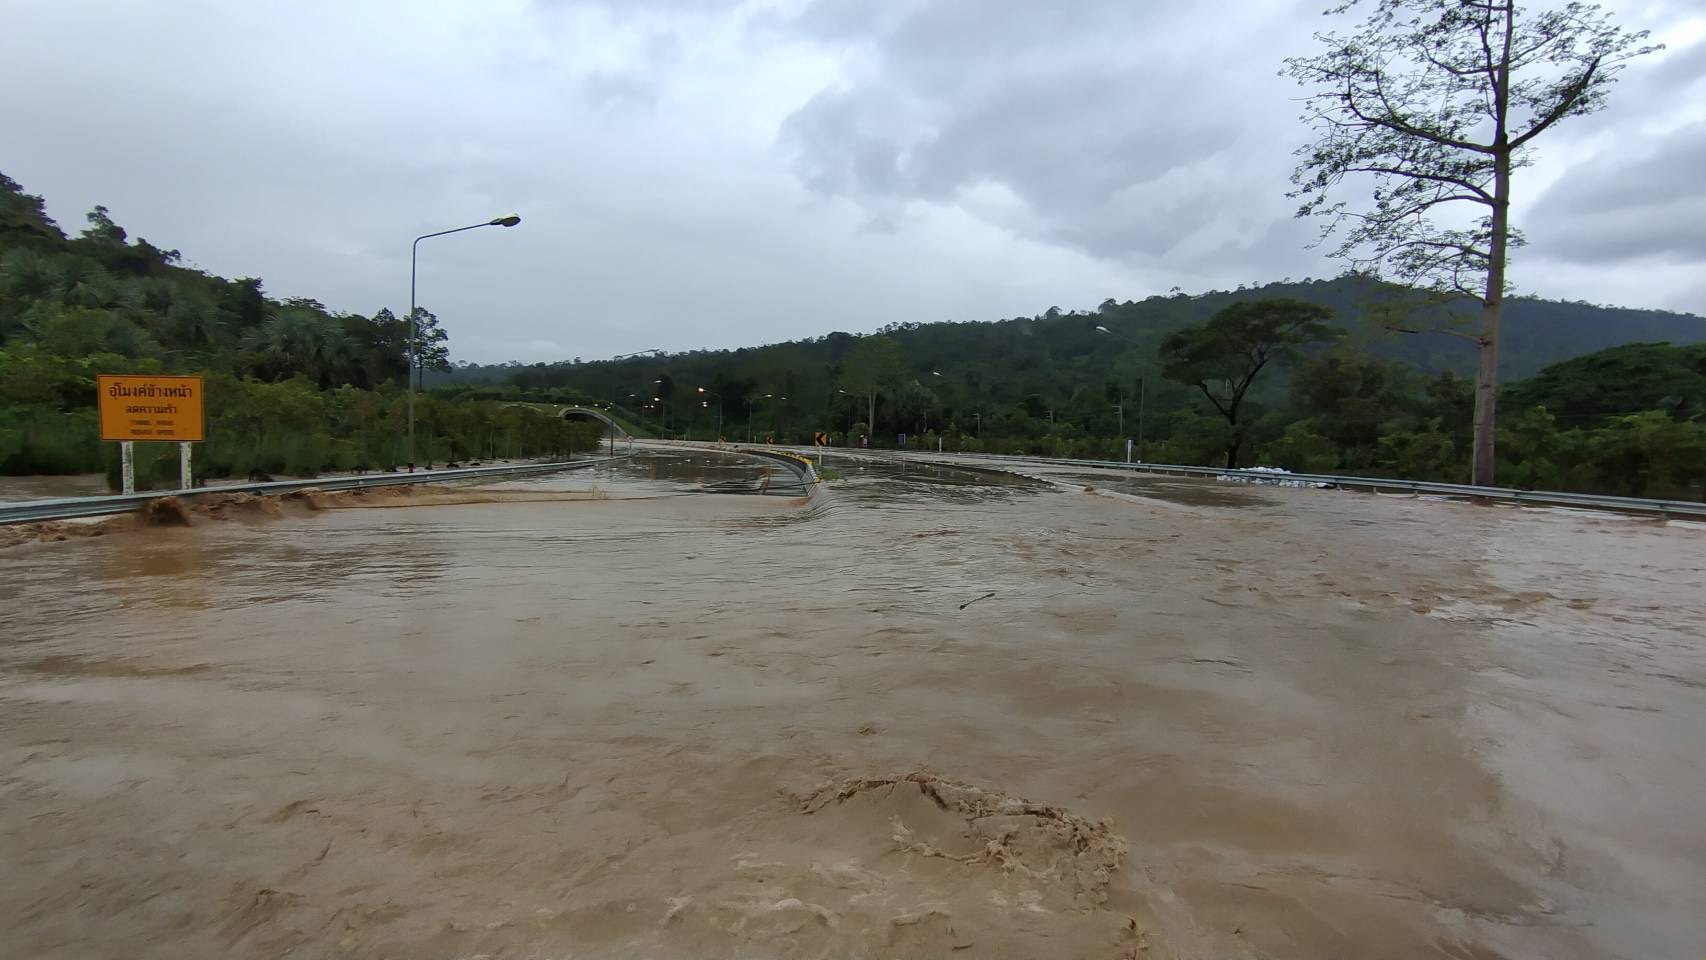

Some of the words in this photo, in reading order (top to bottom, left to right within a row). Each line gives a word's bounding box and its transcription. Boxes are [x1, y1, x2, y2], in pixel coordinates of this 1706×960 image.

[109, 382, 192, 399] อุโมงค์ข้างหน้า
